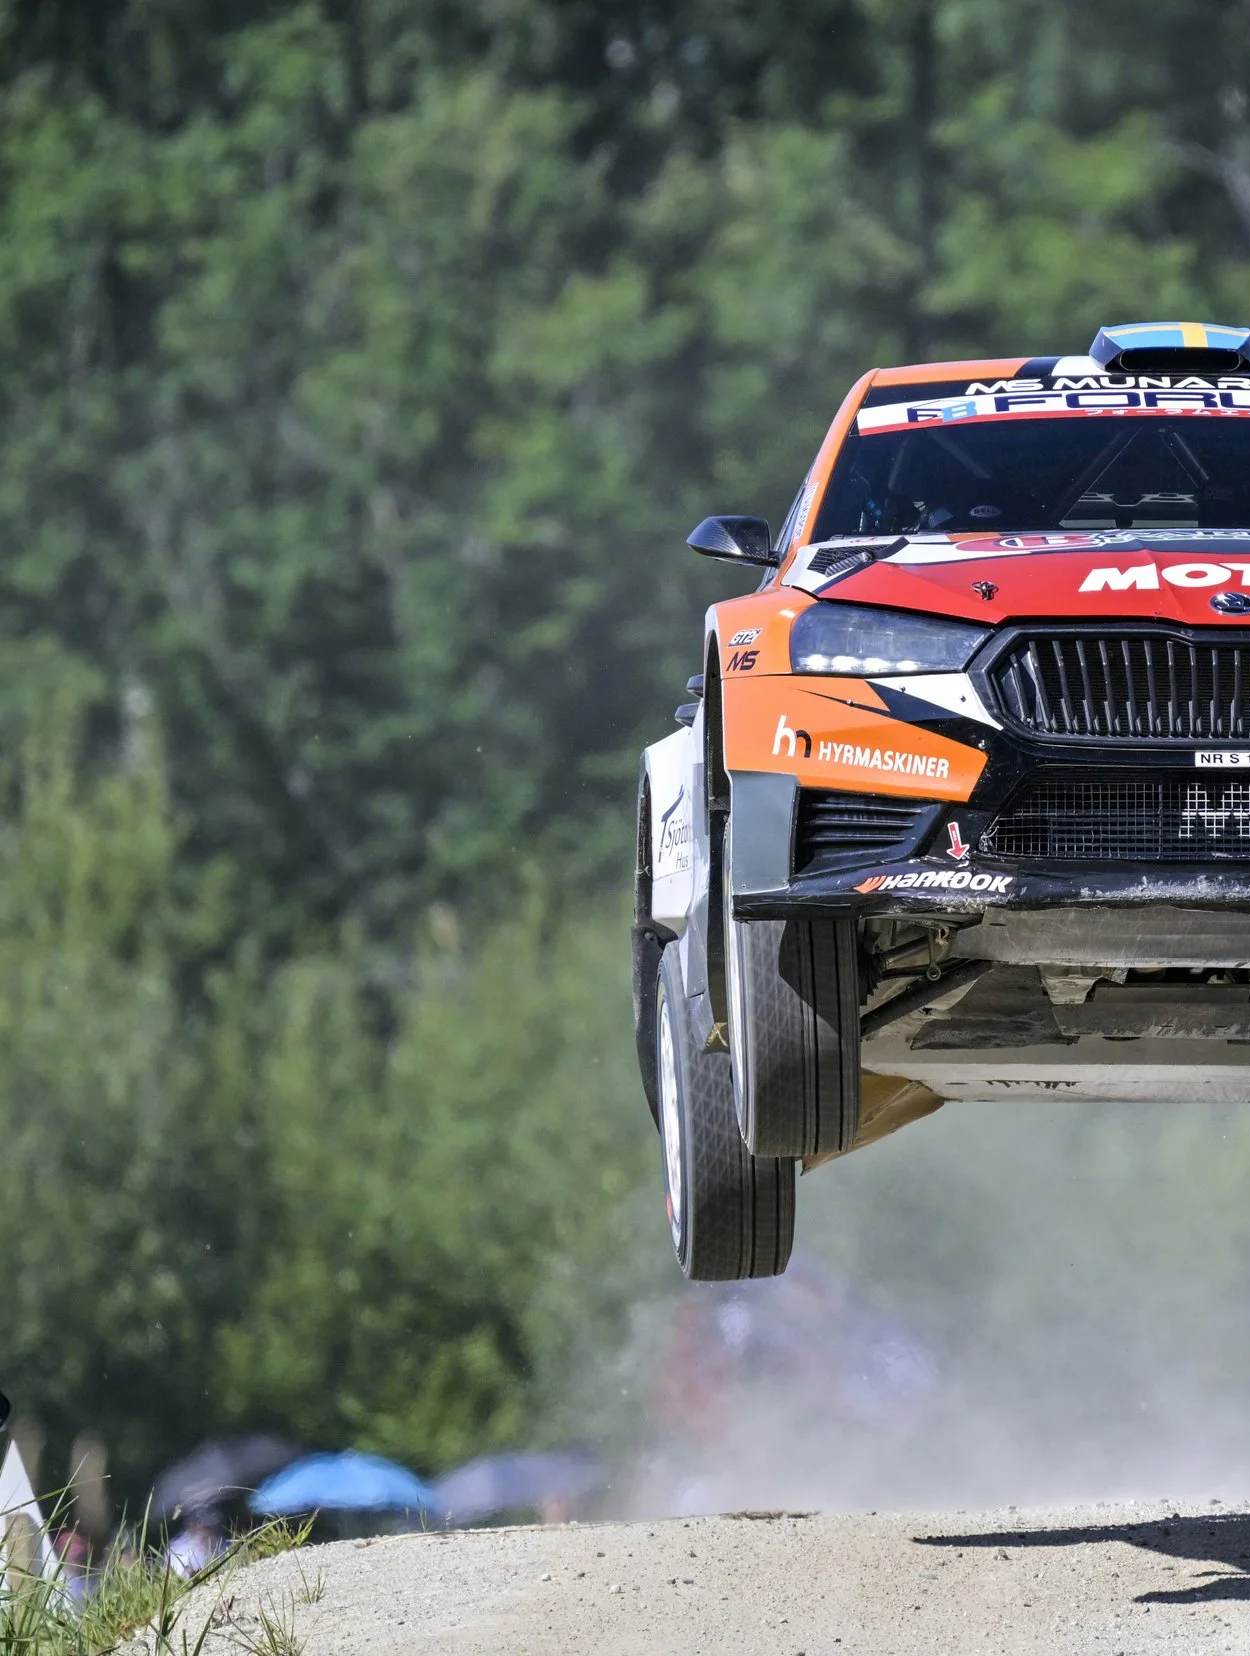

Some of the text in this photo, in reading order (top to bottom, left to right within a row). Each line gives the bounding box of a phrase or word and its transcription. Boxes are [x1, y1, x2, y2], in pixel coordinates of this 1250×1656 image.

[965, 378, 1044, 395] MS
[726, 650, 760, 671] MS
[818, 740, 950, 779] HYRMASKINER
[1200, 753, 1224, 764] NR
[1229, 753, 1241, 764] S
